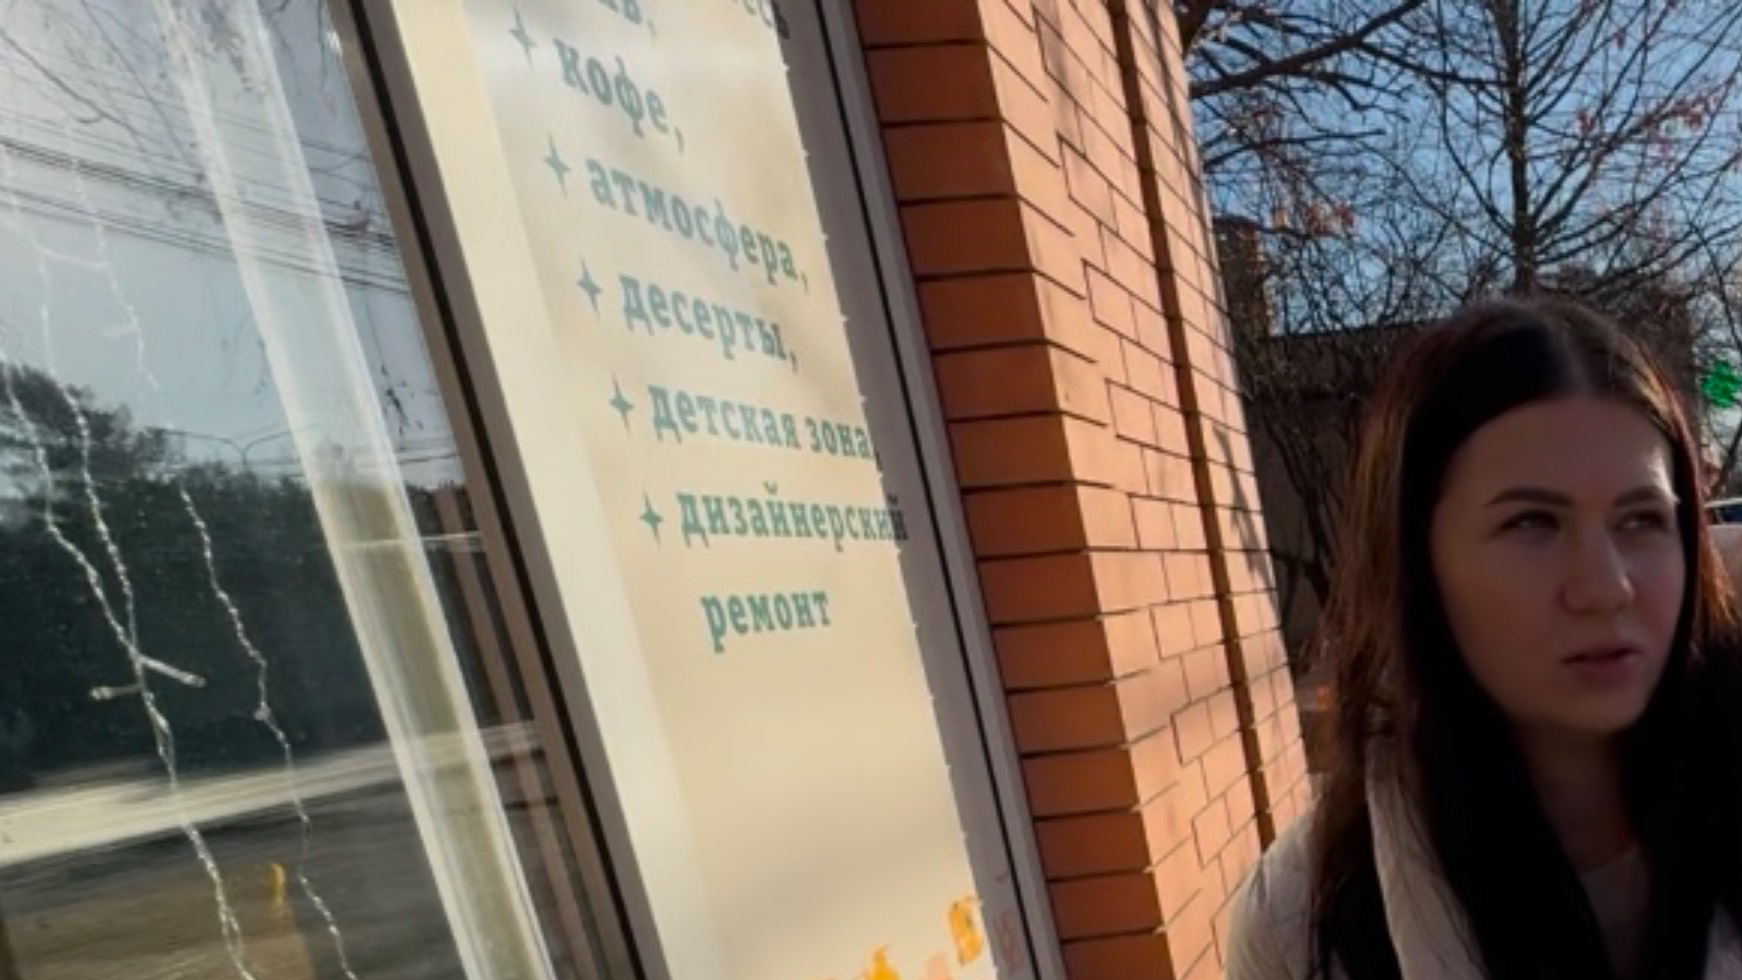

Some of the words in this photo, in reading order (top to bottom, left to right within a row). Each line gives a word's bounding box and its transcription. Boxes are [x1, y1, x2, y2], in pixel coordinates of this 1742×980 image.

[553, 37, 683, 155] кофе,
[586, 157, 808, 293] атмосфера,
[618, 273, 798, 374] десерты,
[647, 384, 802, 445] детская
[676, 479, 909, 552] дизайнерский
[699, 590, 830, 654] ремонт
